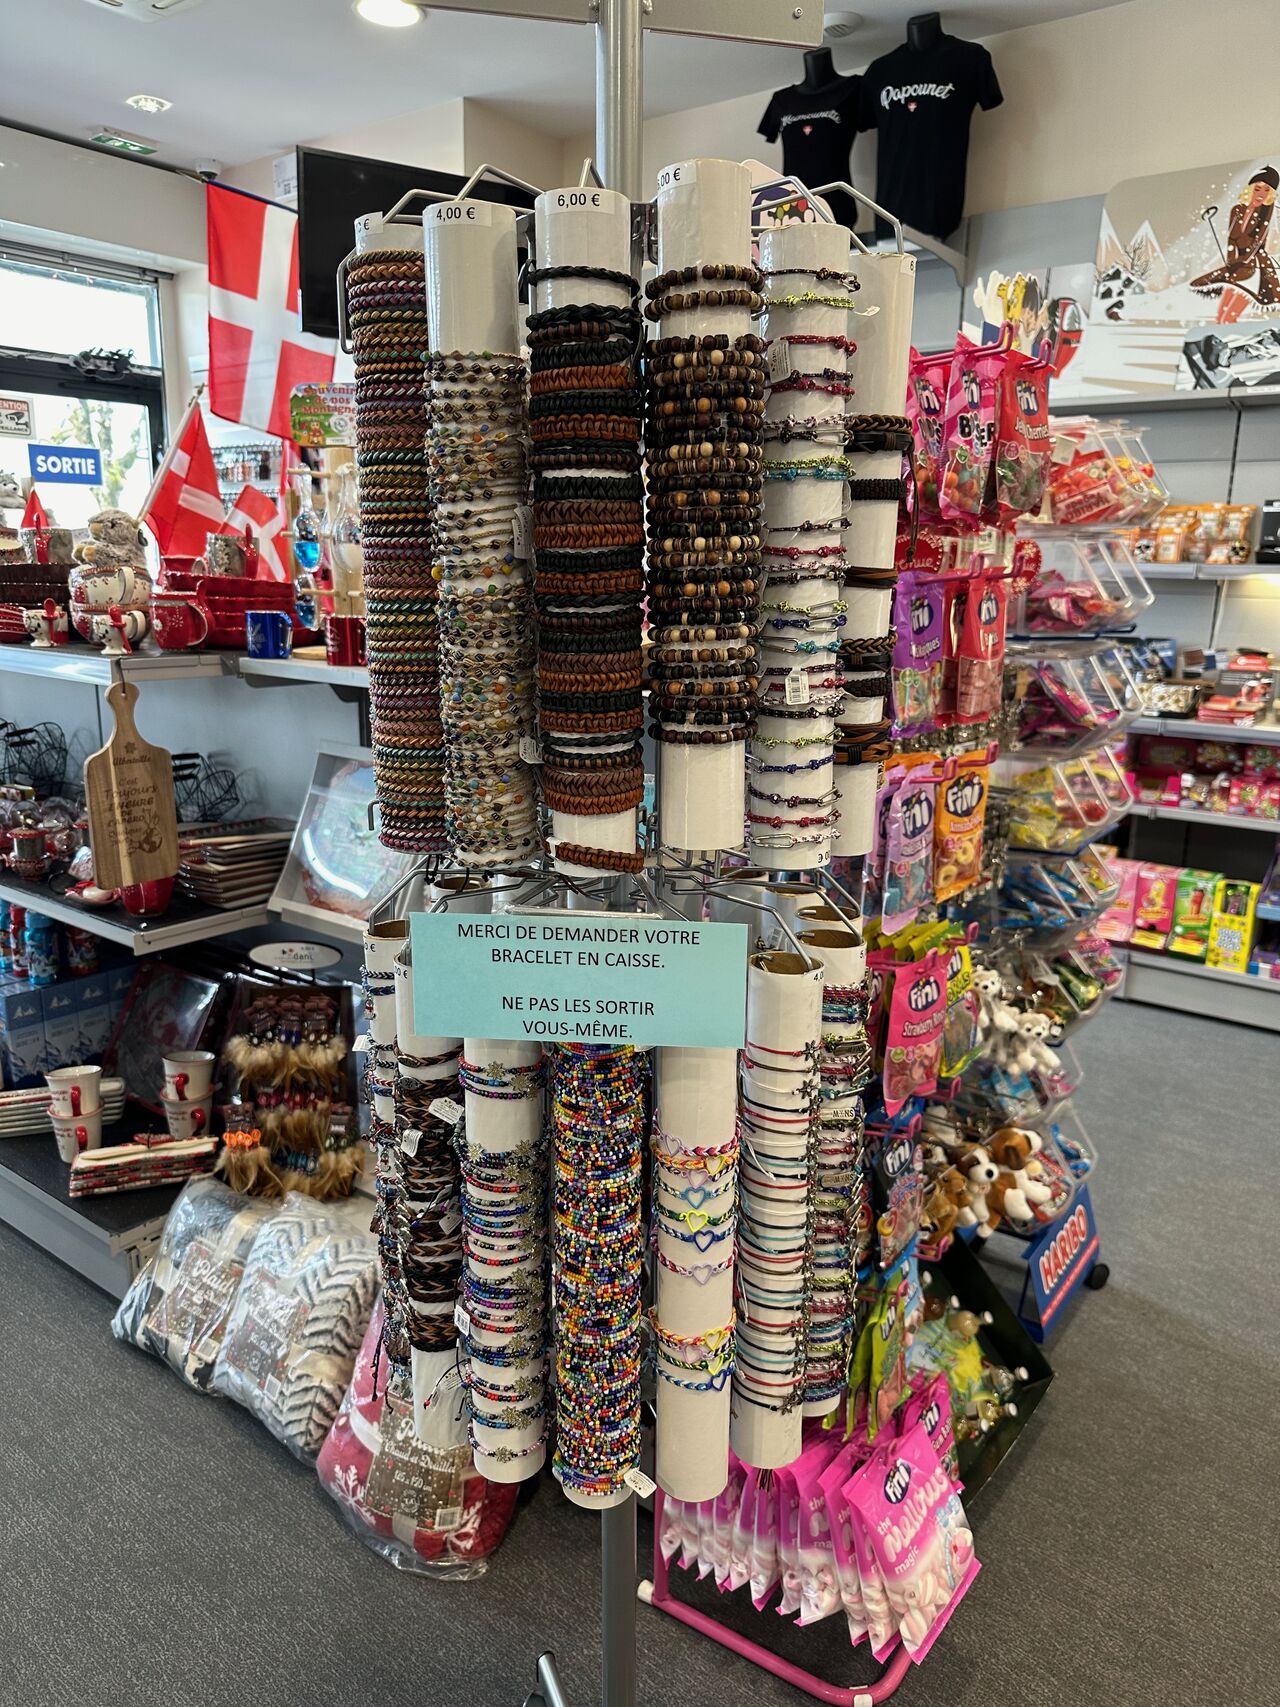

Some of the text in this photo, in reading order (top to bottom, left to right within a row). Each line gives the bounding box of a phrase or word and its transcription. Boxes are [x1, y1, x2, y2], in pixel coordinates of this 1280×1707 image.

[880, 82, 955, 110] Papounet
[673, 168, 681, 181] €
[557, 193, 601, 208] 6,00 €
[436, 207, 476, 221] 4,00 €
[36, 455, 97, 476] SORTIE
[946, 774, 981, 814] Fini
[457, 923, 701, 945] MERCI DE DEMANDER VOTRE
[491, 948, 666, 968] BRACELET EN CAISSE.
[909, 976, 939, 1009] Fini
[501, 996, 655, 1016] NE PAS LES SORTIR
[522, 1018, 634, 1039] VOUS-MÊME.
[885, 1139, 911, 1174] Fini
[1039, 1204, 1088, 1295] HARIBO
[885, 1457, 910, 1503] Fini
[876, 1516, 892, 1536] the
[883, 1466, 949, 1564] Mellows
[894, 1545, 920, 1576] magic
